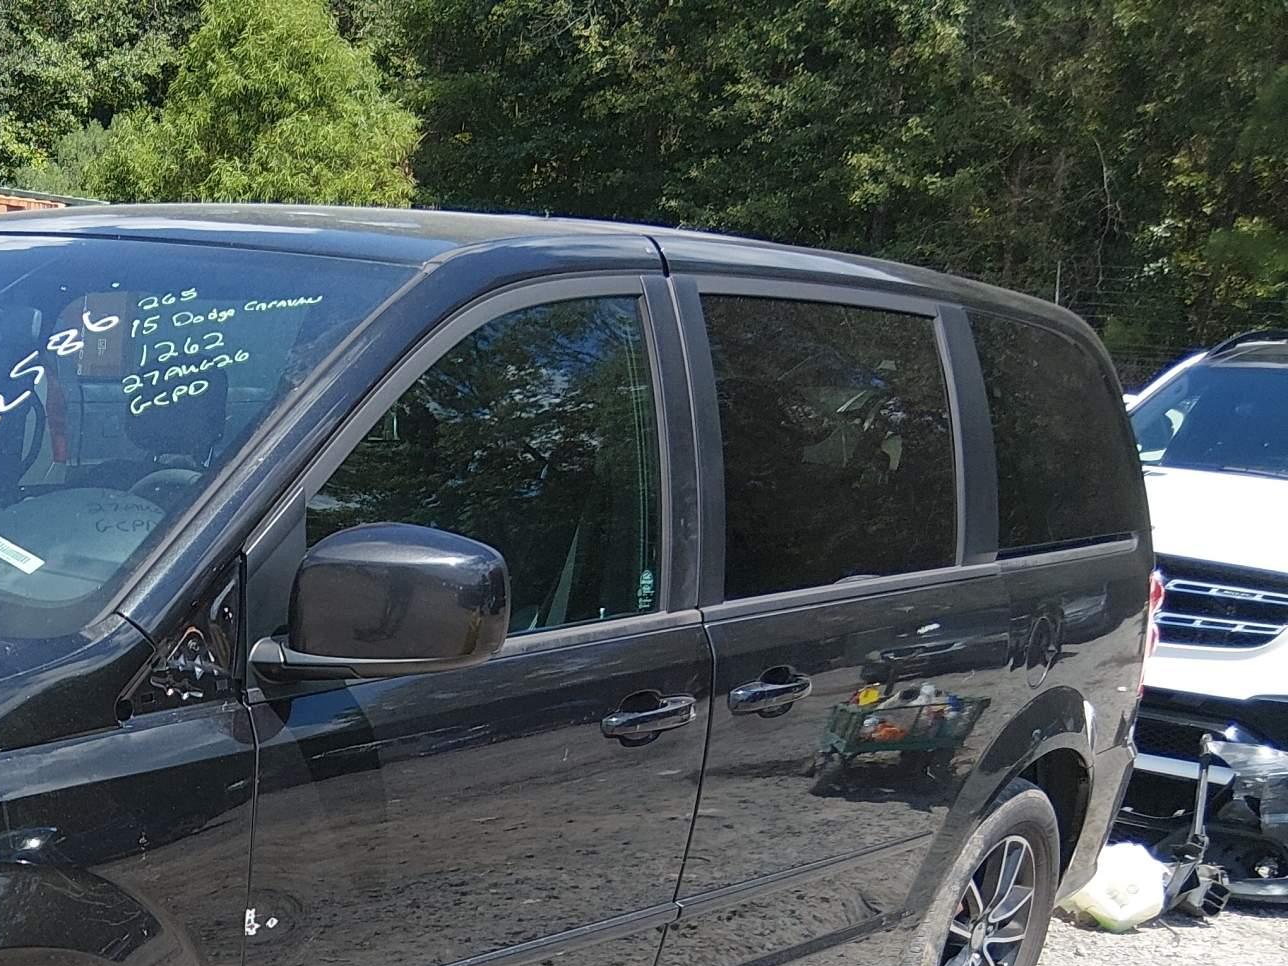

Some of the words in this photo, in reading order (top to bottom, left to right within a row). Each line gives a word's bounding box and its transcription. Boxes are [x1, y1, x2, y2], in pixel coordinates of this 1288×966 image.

[138, 288, 197, 310] 265
[131, 315, 160, 337] 15
[173, 308, 235, 327] Dodge
[140, 333, 225, 366] 1262
[130, 380, 209, 415] GCPD
